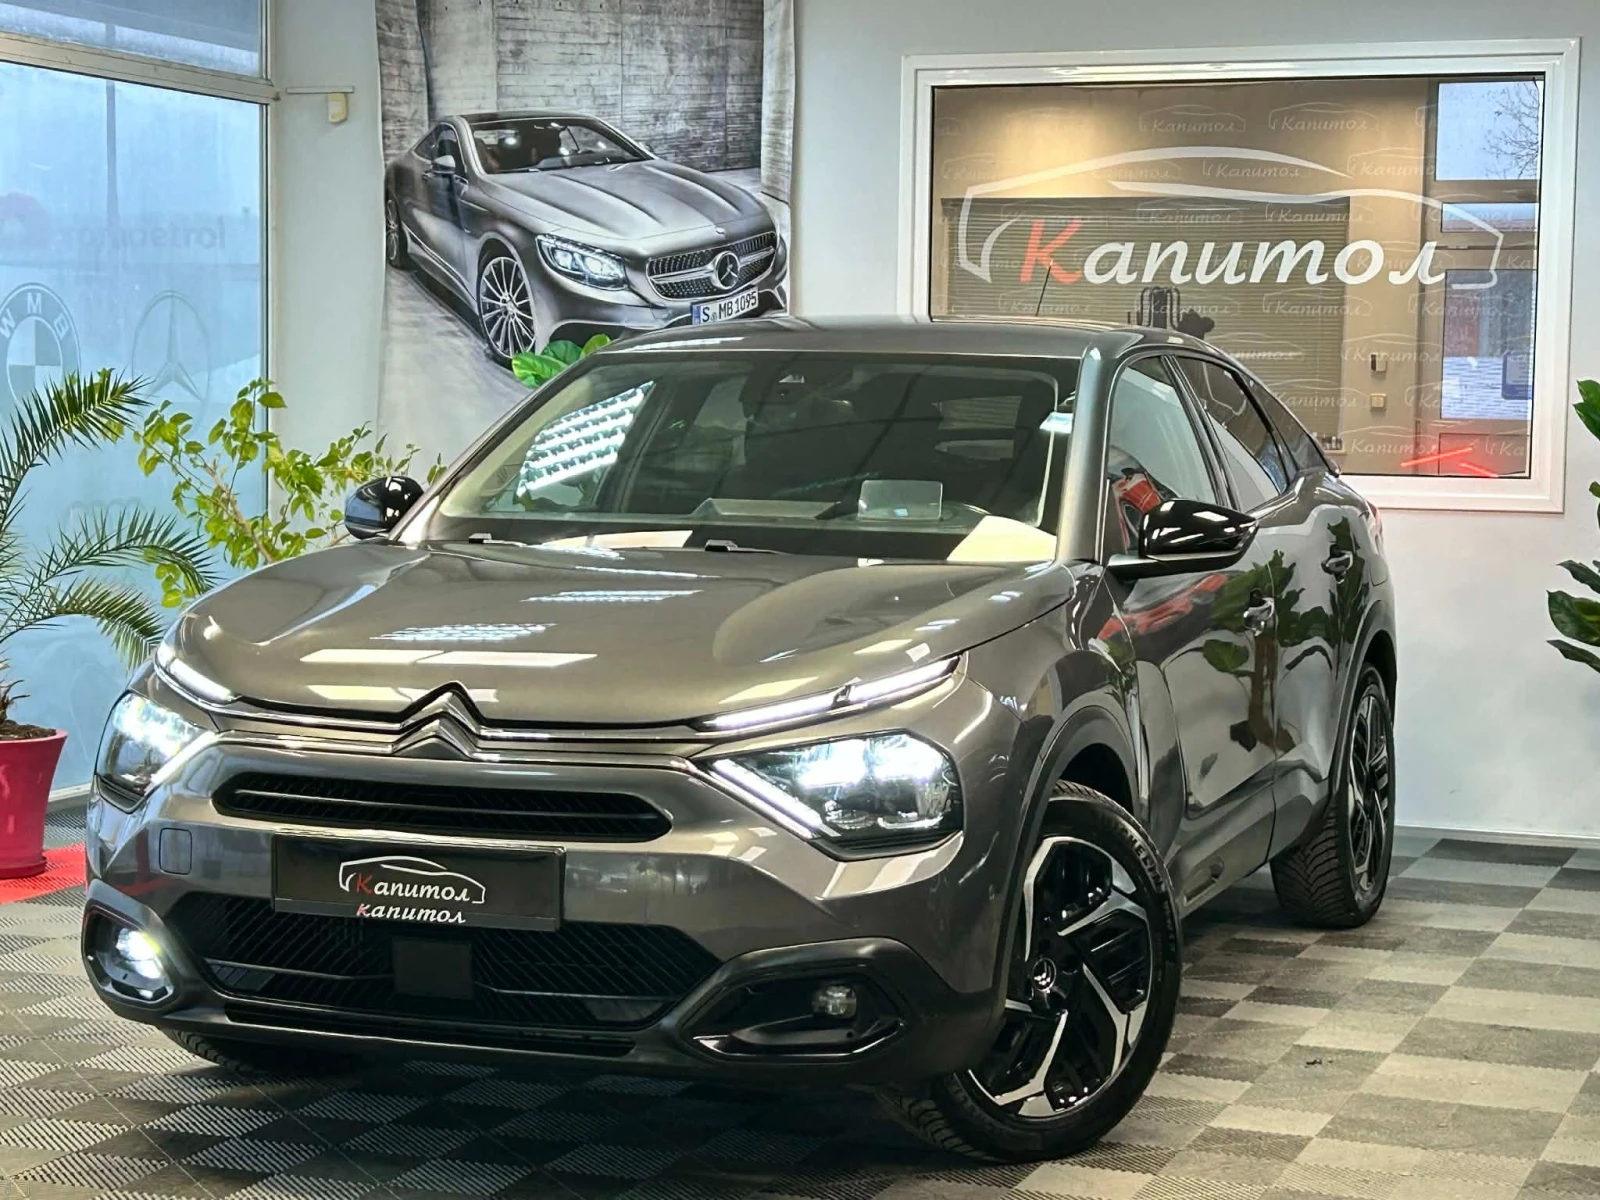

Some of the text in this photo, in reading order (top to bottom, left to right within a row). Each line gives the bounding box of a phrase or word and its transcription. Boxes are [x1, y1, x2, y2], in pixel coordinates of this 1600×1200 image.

[1018, 219, 1446, 286] Капитол
[702, 306, 710, 323] S
[356, 874, 470, 902] Капитол
